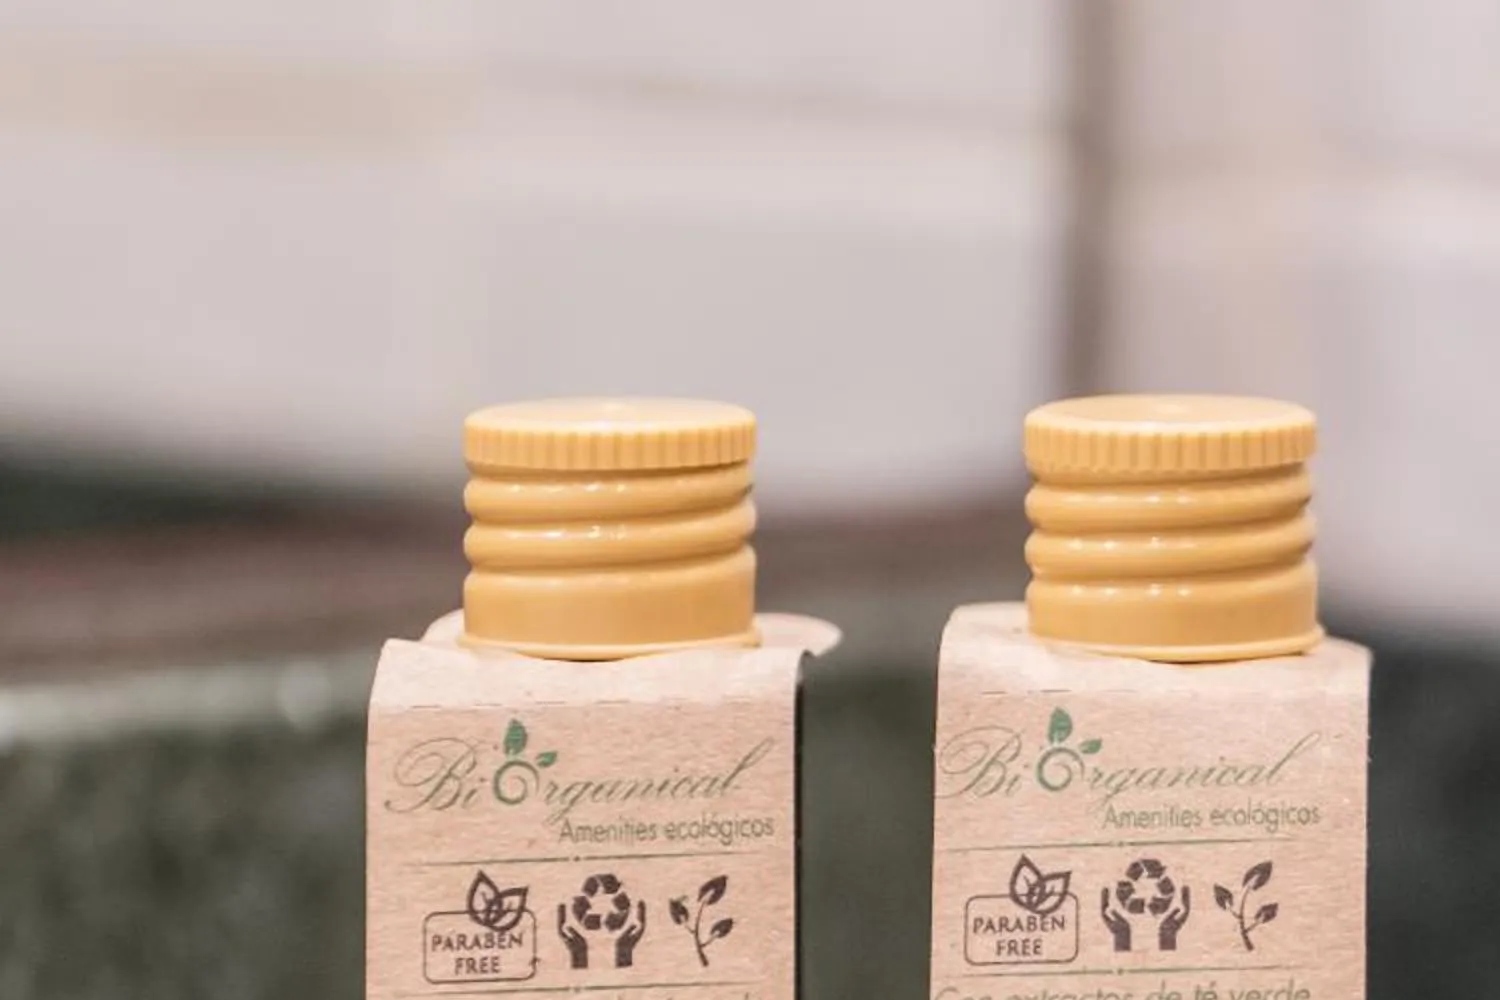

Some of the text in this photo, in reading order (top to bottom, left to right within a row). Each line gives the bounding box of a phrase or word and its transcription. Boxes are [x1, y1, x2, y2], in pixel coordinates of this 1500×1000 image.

[1103, 799, 1321, 832] Amenities ecológicos
[558, 813, 776, 847] Amenities ecológicos
[972, 915, 1066, 936] PARABEN
[430, 932, 524, 953] PARABEN
[995, 937, 1043, 957] FREE
[453, 955, 502, 977] FREE
